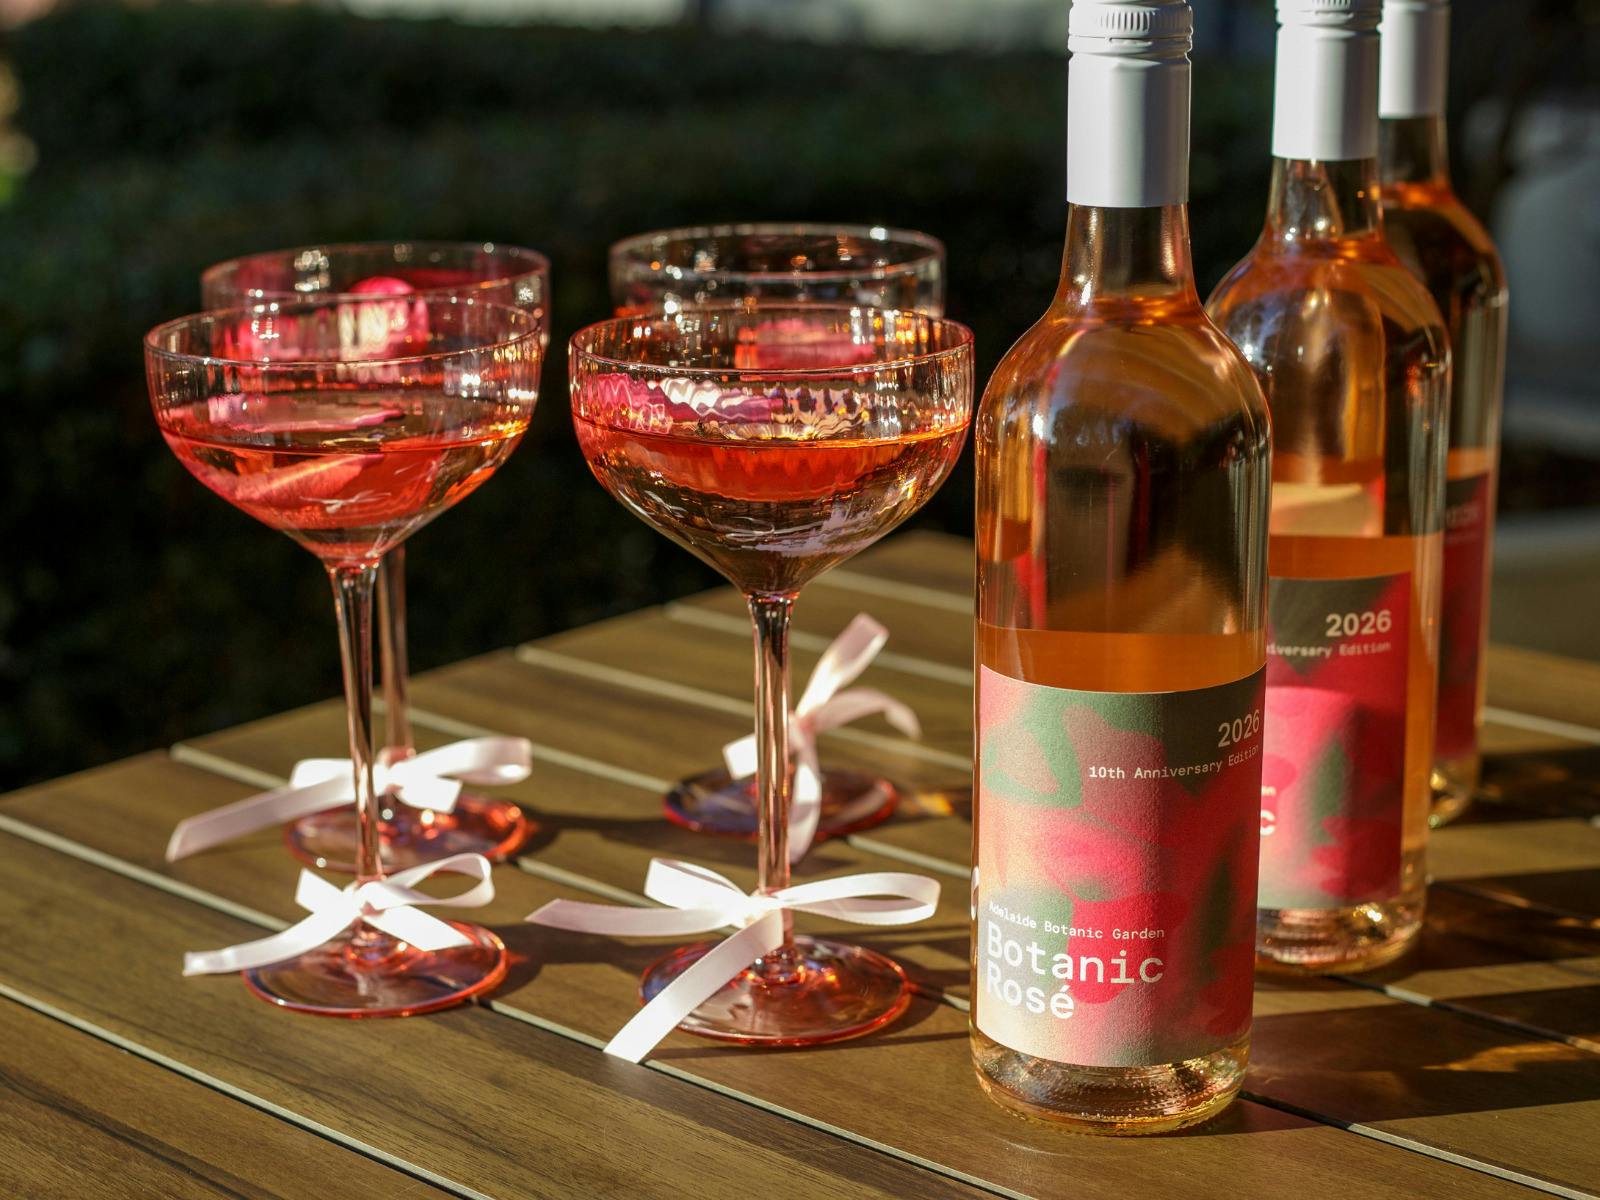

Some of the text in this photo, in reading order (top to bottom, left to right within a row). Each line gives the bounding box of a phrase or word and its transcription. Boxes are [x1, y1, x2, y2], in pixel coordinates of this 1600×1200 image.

[1326, 609, 1392, 637] 2026
[1339, 641, 1392, 656] Edition
[1217, 709, 1261, 748] 2026
[1089, 745, 1260, 780] 10th Anniversary Edition
[988, 900, 1165, 940] Adelaide Botanic Garden
[987, 920, 1164, 984] Botanic
[987, 958, 1075, 1019] Rosé
